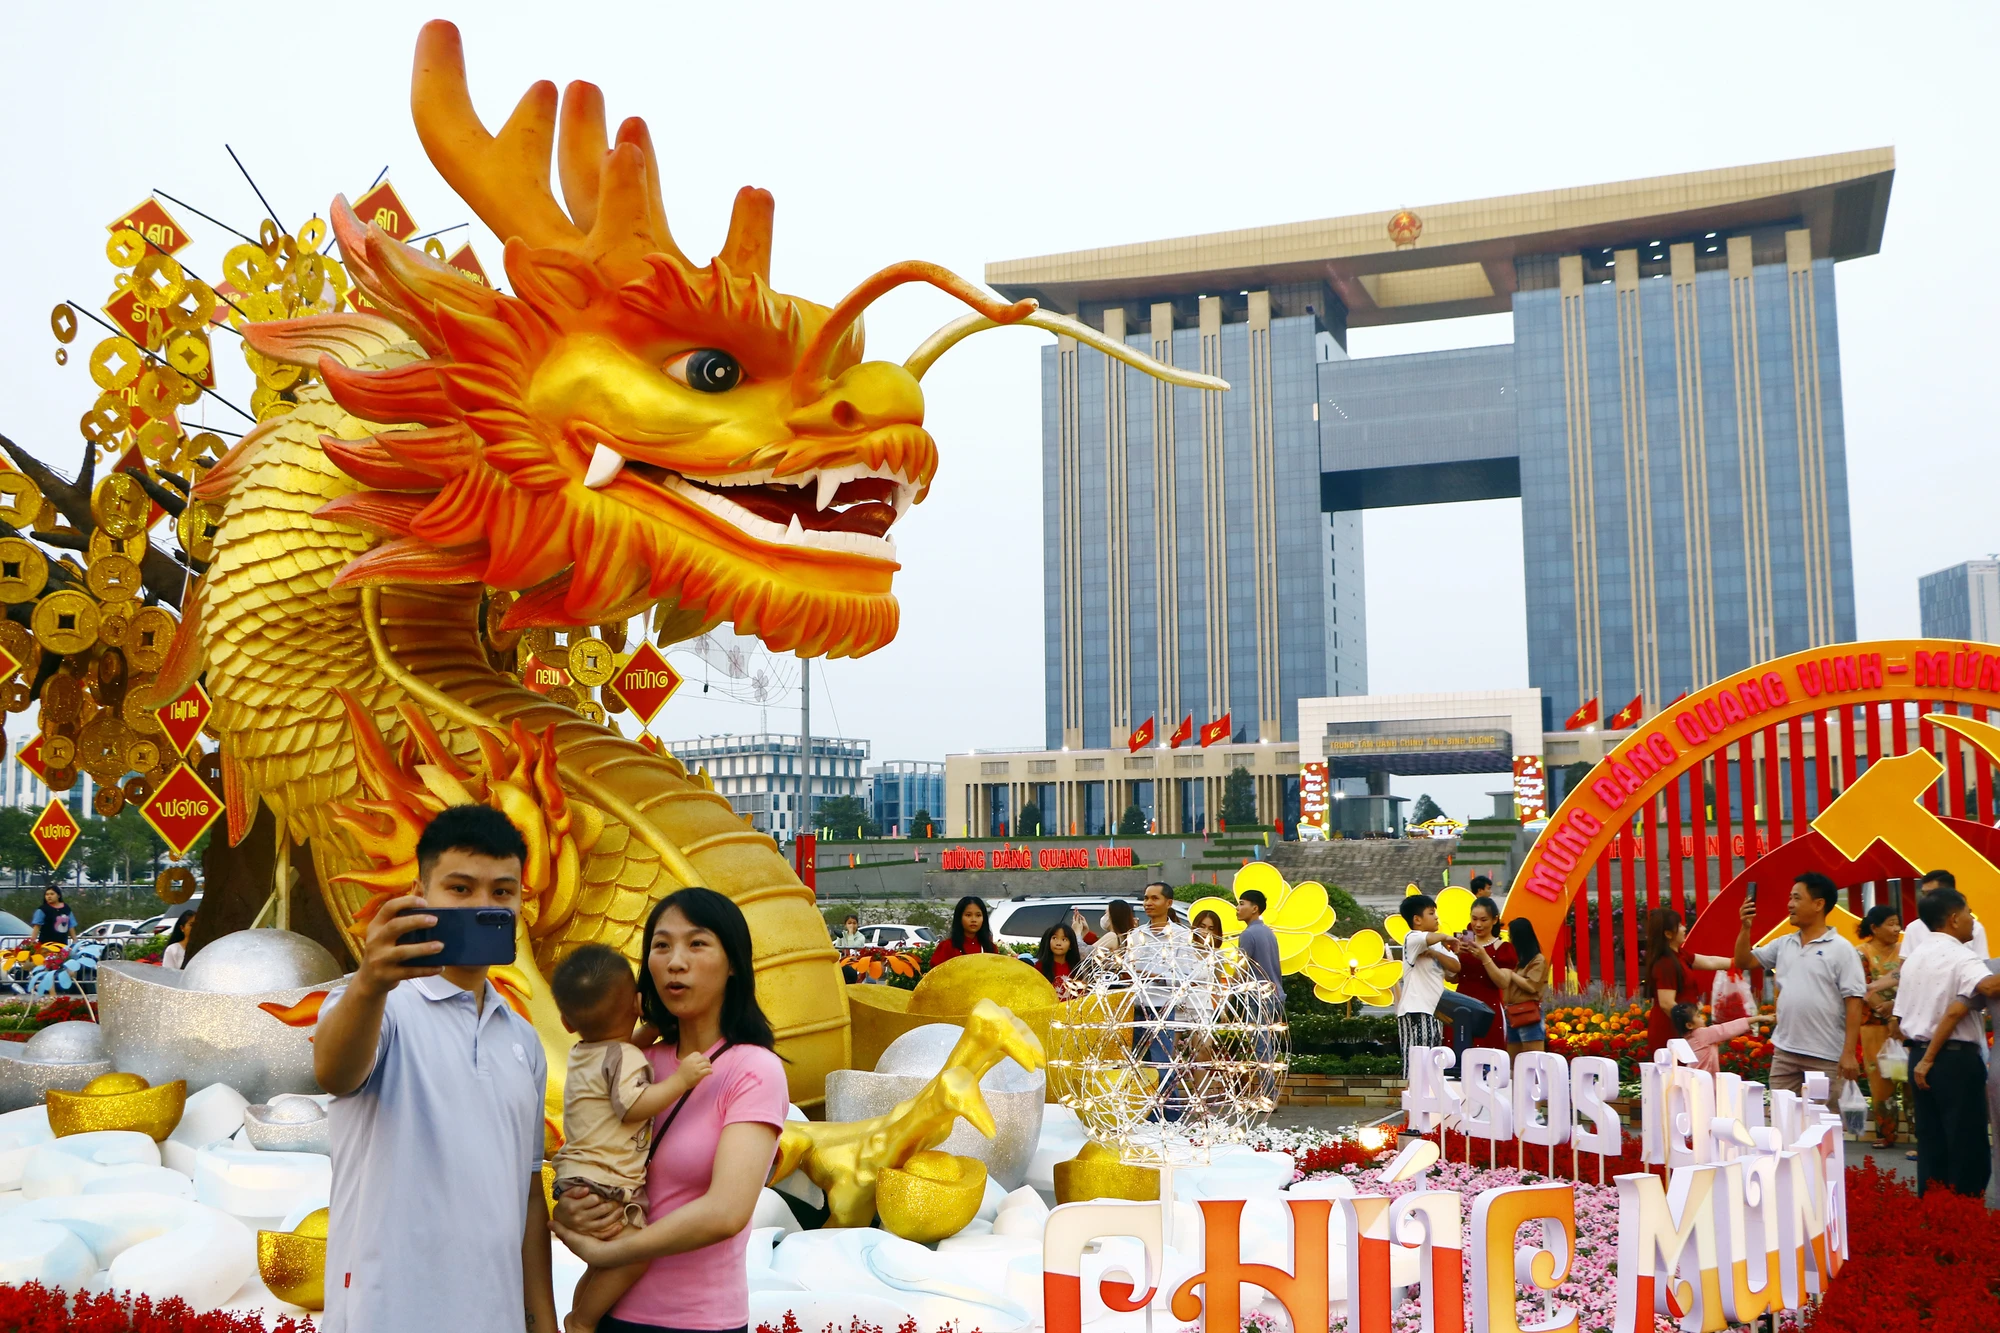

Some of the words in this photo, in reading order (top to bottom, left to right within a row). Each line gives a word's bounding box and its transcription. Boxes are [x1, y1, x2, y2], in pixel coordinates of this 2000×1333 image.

[1525, 807, 1603, 903] MỪNG
[1675, 671, 1790, 745] QUANG
[1795, 653, 1882, 697] VINH
[942, 845, 985, 870] MỪNG
[992, 842, 1032, 869] ĐẢNG
[1039, 848, 1088, 871] QUANG
[1096, 847, 1132, 867] VINH
